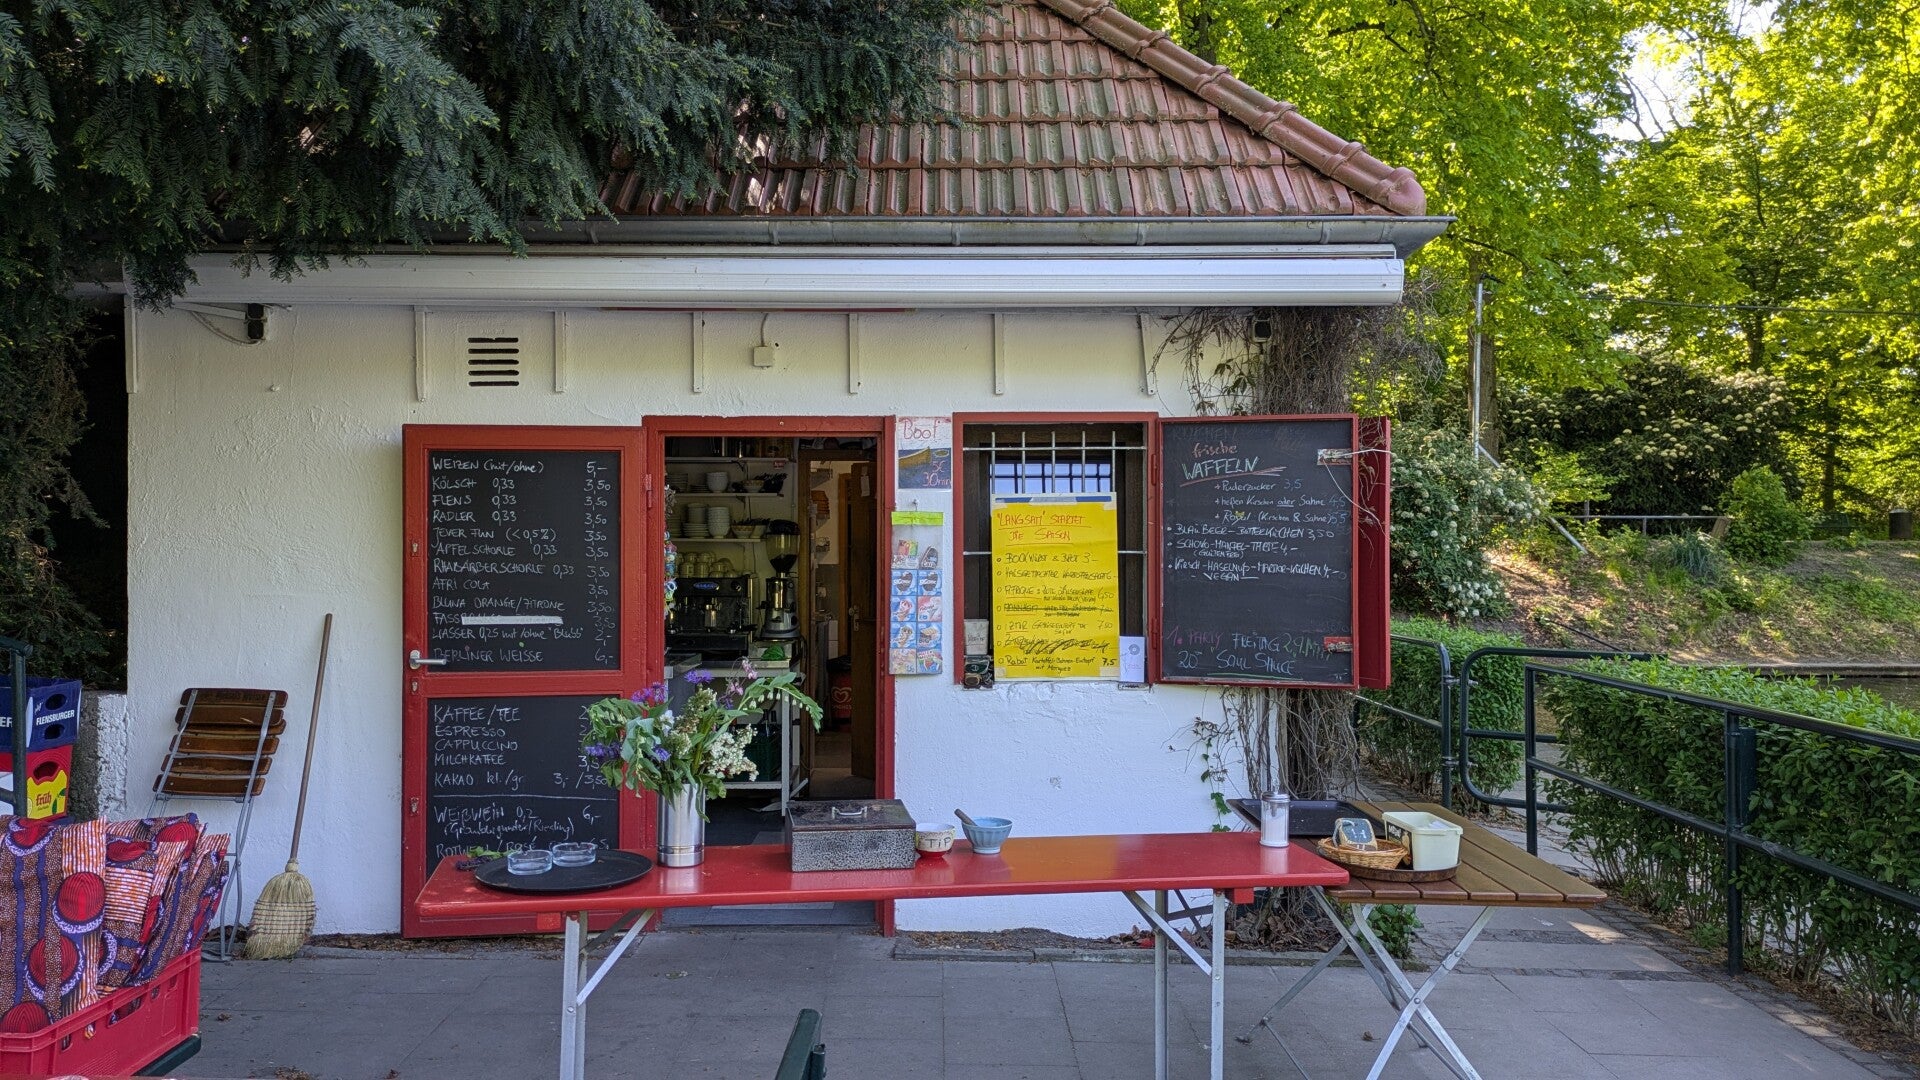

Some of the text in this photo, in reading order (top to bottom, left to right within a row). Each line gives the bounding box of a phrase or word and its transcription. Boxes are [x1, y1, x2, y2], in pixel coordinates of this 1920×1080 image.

[1182, 456, 1260, 481] WAFFELN
[492, 477, 515, 494] 0,33
[583, 478, 611, 495] 3,50
[1221, 479, 1277, 493] Puderzucker
[432, 494, 608, 512] FLENS 0,33 3,50
[1277, 496, 1296, 506] oder
[1299, 493, 1327, 507] Sahne
[432, 510, 607, 529] RADLER 0,33 3,50
[532, 544, 558, 561] 0,33
[585, 546, 609, 562] 3,50
[552, 564, 576, 580] 0,33
[499, 649, 544, 663] WEISSE
[1216, 648, 1252, 671] SOUL
[1254, 652, 1296, 676] SAUCE
[36, 709, 75, 726] FLENSBURGER
[434, 725, 506, 738] ESPRESSO
[434, 772, 475, 788] KAKAO
